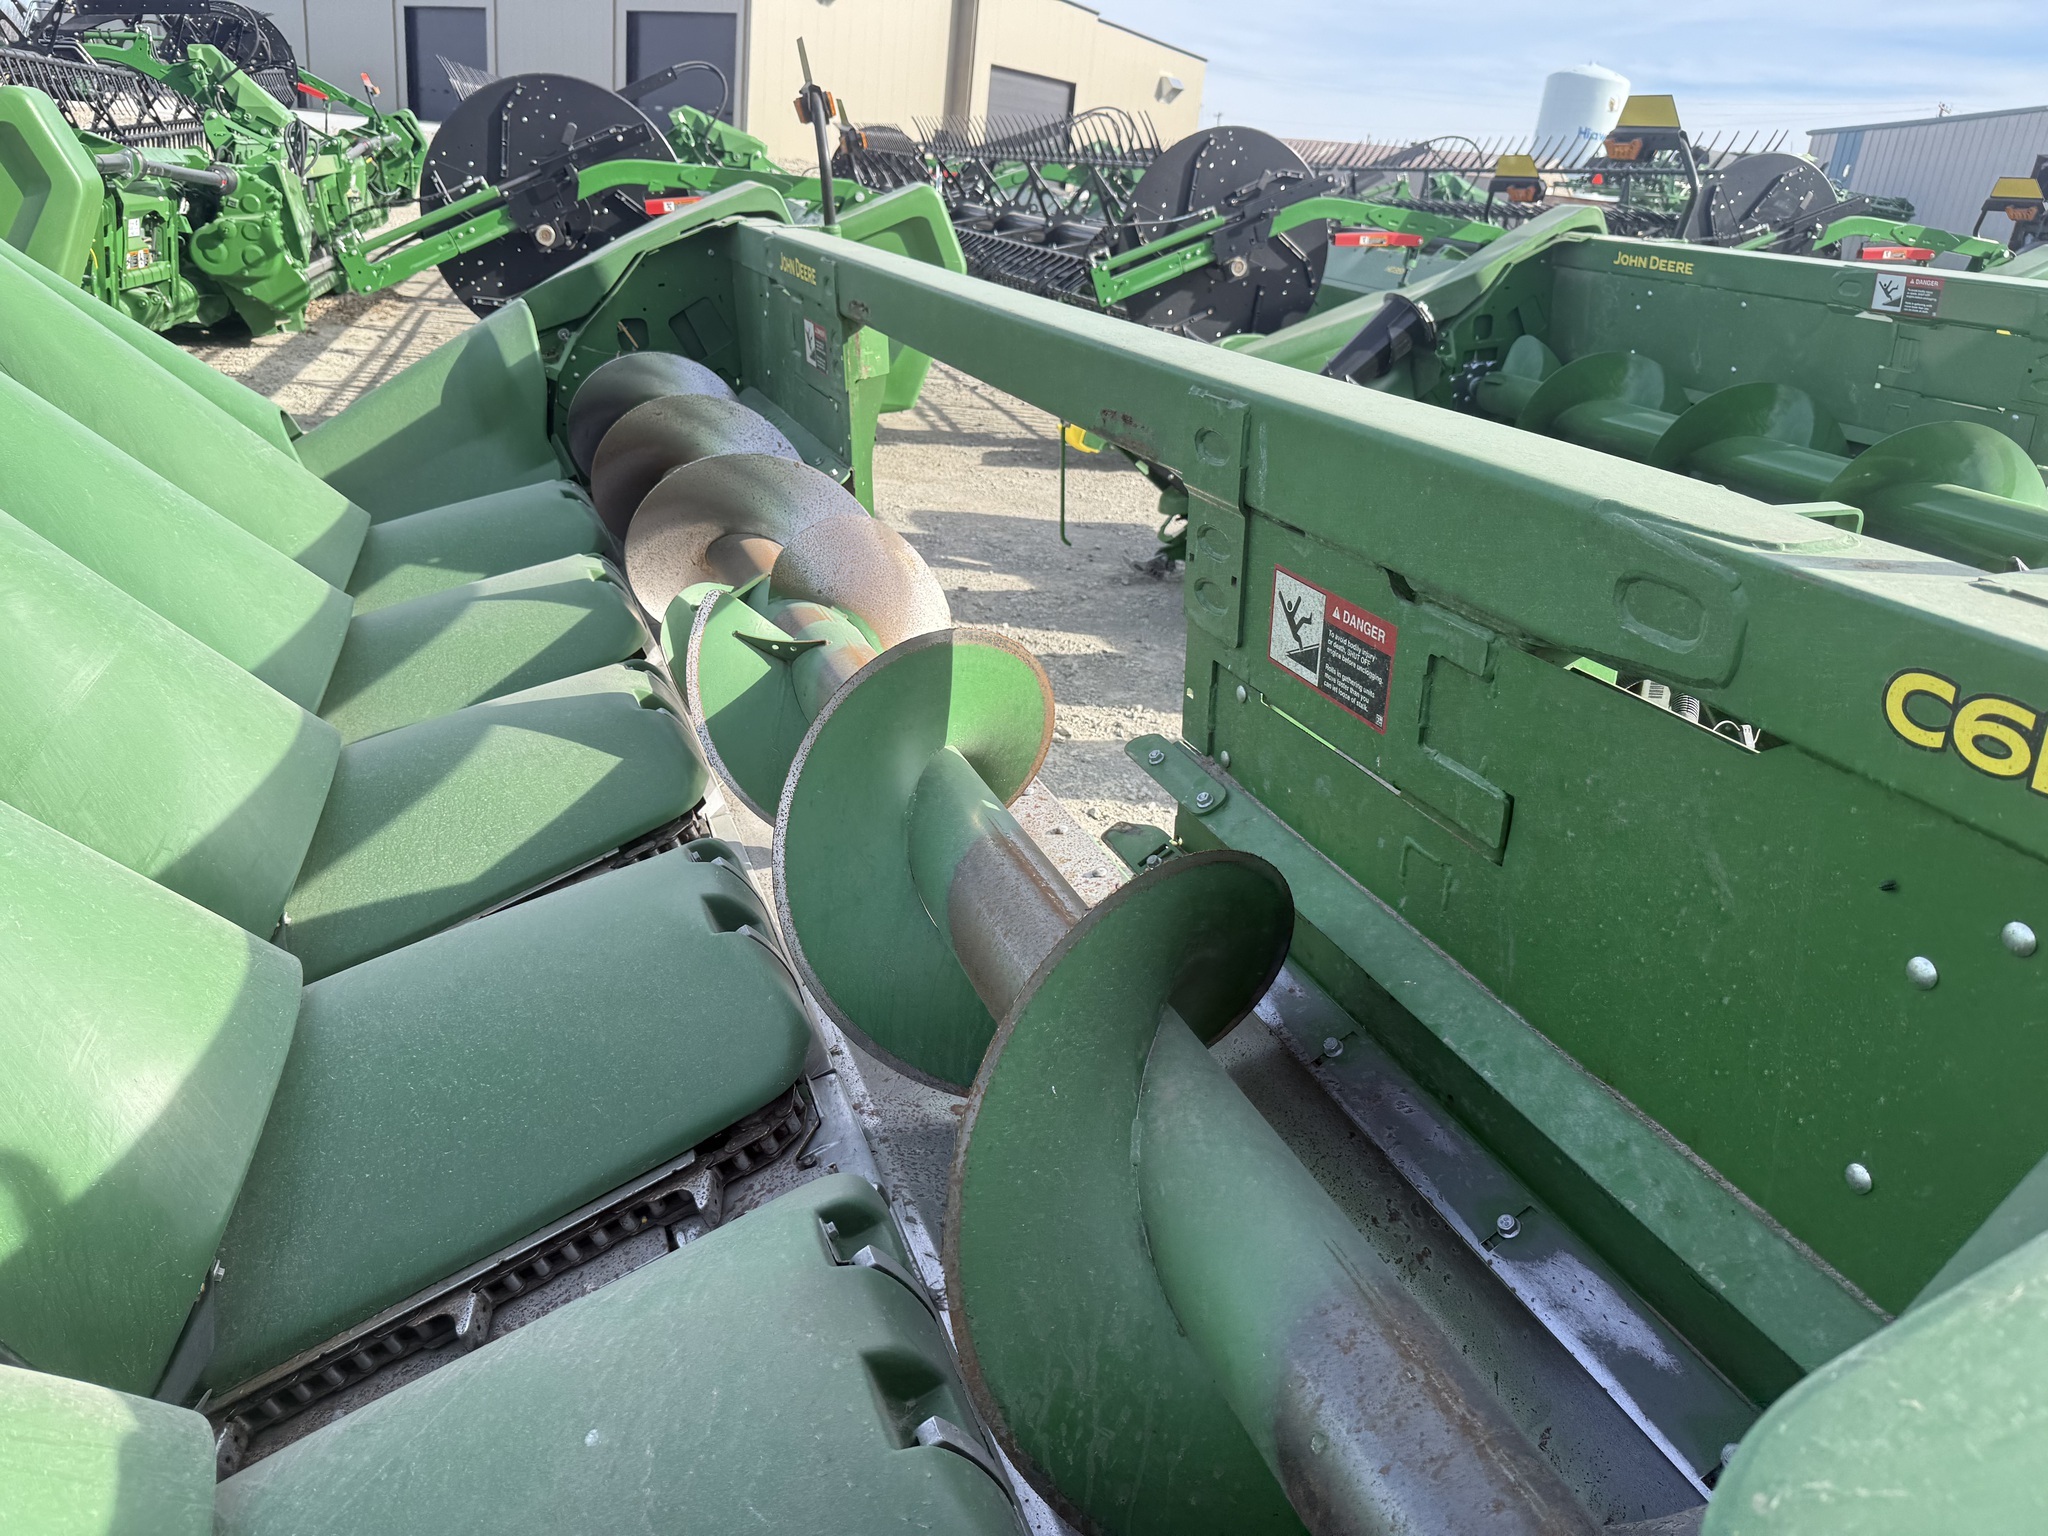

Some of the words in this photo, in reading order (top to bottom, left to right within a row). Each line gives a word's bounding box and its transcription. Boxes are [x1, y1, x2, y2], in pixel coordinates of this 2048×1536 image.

[780, 252, 795, 276] JOHN
[795, 257, 817, 286] DEERE
[1613, 251, 1648, 269] JOHN
[1649, 255, 1695, 275] DEERE
[1343, 610, 1386, 644] DANGER
[1328, 629, 1335, 638] To
[1335, 634, 1348, 645] avoid
[1347, 640, 1361, 654] bodily
[1326, 647, 1341, 660] engine
[1341, 655, 1356, 668] before
[1347, 648, 1360, 660] SHUT
[1360, 657, 1371, 666] OFF
[1323, 680, 1332, 689] can
[1338, 688, 1350, 701] loose
[1325, 663, 1336, 675] Rolls
[1336, 670, 1342, 678] in
[1341, 674, 1363, 692] gathering
[1363, 687, 1375, 698] units
[1349, 686, 1360, 698] than
[1360, 695, 1370, 704] you
